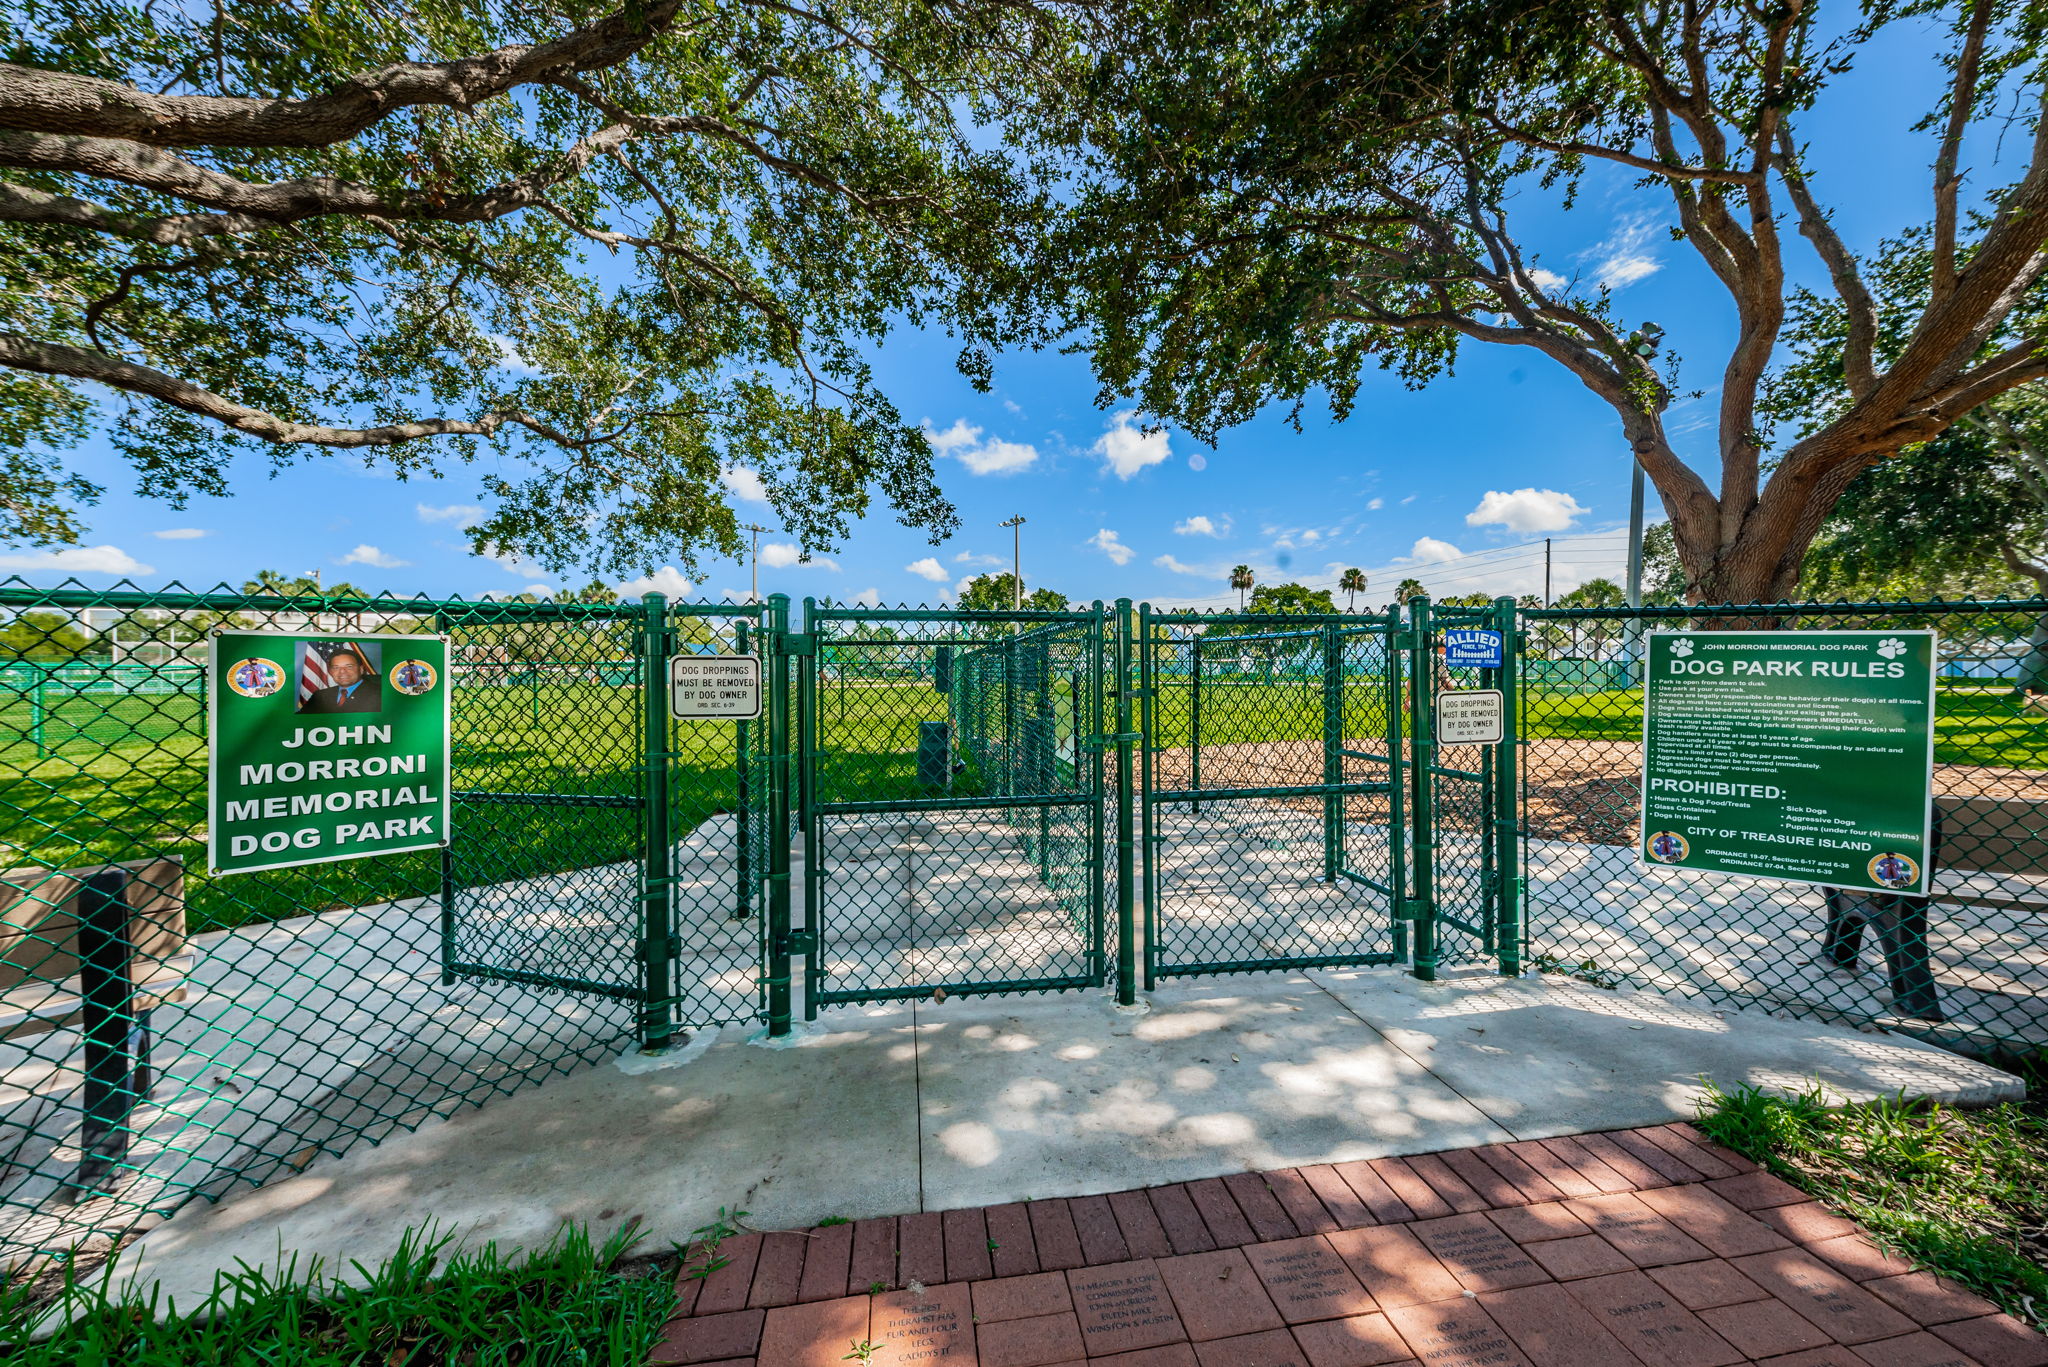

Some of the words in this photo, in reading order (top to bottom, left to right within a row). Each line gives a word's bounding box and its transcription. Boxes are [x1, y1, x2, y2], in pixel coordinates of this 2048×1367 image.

[1447, 632, 1500, 647] ALLIED
[1670, 659, 1724, 675] DOG
[1732, 660, 1803, 676] PARK
[1811, 661, 1904, 678] RULES
[677, 679, 698, 687] MUST
[703, 679, 712, 687] BE
[717, 679, 754, 687] REMOVED
[684, 691, 695, 699] BY
[699, 691, 715, 699] DOG
[720, 691, 747, 699] OWNER
[1461, 699, 1494, 708] DROPPINGS
[1448, 721, 1455, 729] BY
[281, 724, 391, 748] JOHN
[1656, 754, 1693, 762] Aggressive
[240, 754, 426, 786] MORRONI
[1666, 767, 1692, 775] digging
[1651, 777, 1786, 799] PROHIBITED:
[226, 785, 438, 822] MEMORIAL
[1689, 797, 1704, 805] Dog
[1706, 799, 1750, 808] Food/Treats
[1653, 811, 1672, 819] Dogs
[1676, 805, 1716, 814] Containers
[1805, 807, 1827, 815] Dogs
[1785, 814, 1831, 824] Aggressive
[1833, 818, 1855, 826] Dogs
[231, 827, 321, 857] DOG
[335, 815, 434, 845] PARK
[1785, 822, 1818, 832] Puppies
[1820, 826, 1847, 834] (under
[1882, 831, 1919, 841] months)
[1687, 826, 1716, 836] CITY
[1719, 829, 1736, 838] OF
[1740, 831, 1814, 846] TREASURE
[1818, 838, 1871, 851] ISLAND
[1704, 848, 1747, 858] ORDINANCE
[1771, 855, 1798, 863] Section
[1719, 857, 1762, 867] ORDINANCE
[1787, 865, 1814, 873] Section
[1087, 1279, 1123, 1289] MEMORY
[1088, 1303, 1113, 1312] JOHN
[1131, 1307, 1152, 1316] MIKE
[888, 1315, 935, 1327] THERAPIST
[938, 1312, 956, 1321] HAS
[1087, 1322, 1131, 1333] WINSTON
[1142, 1314, 1173, 1325] AUSTIN
[887, 1331, 905, 1339] FUR
[908, 1328, 929, 1336] AND
[932, 1323, 958, 1333] FOUR
[912, 1338, 934, 1347] LEGS
[899, 1349, 938, 1361] CADDYS
